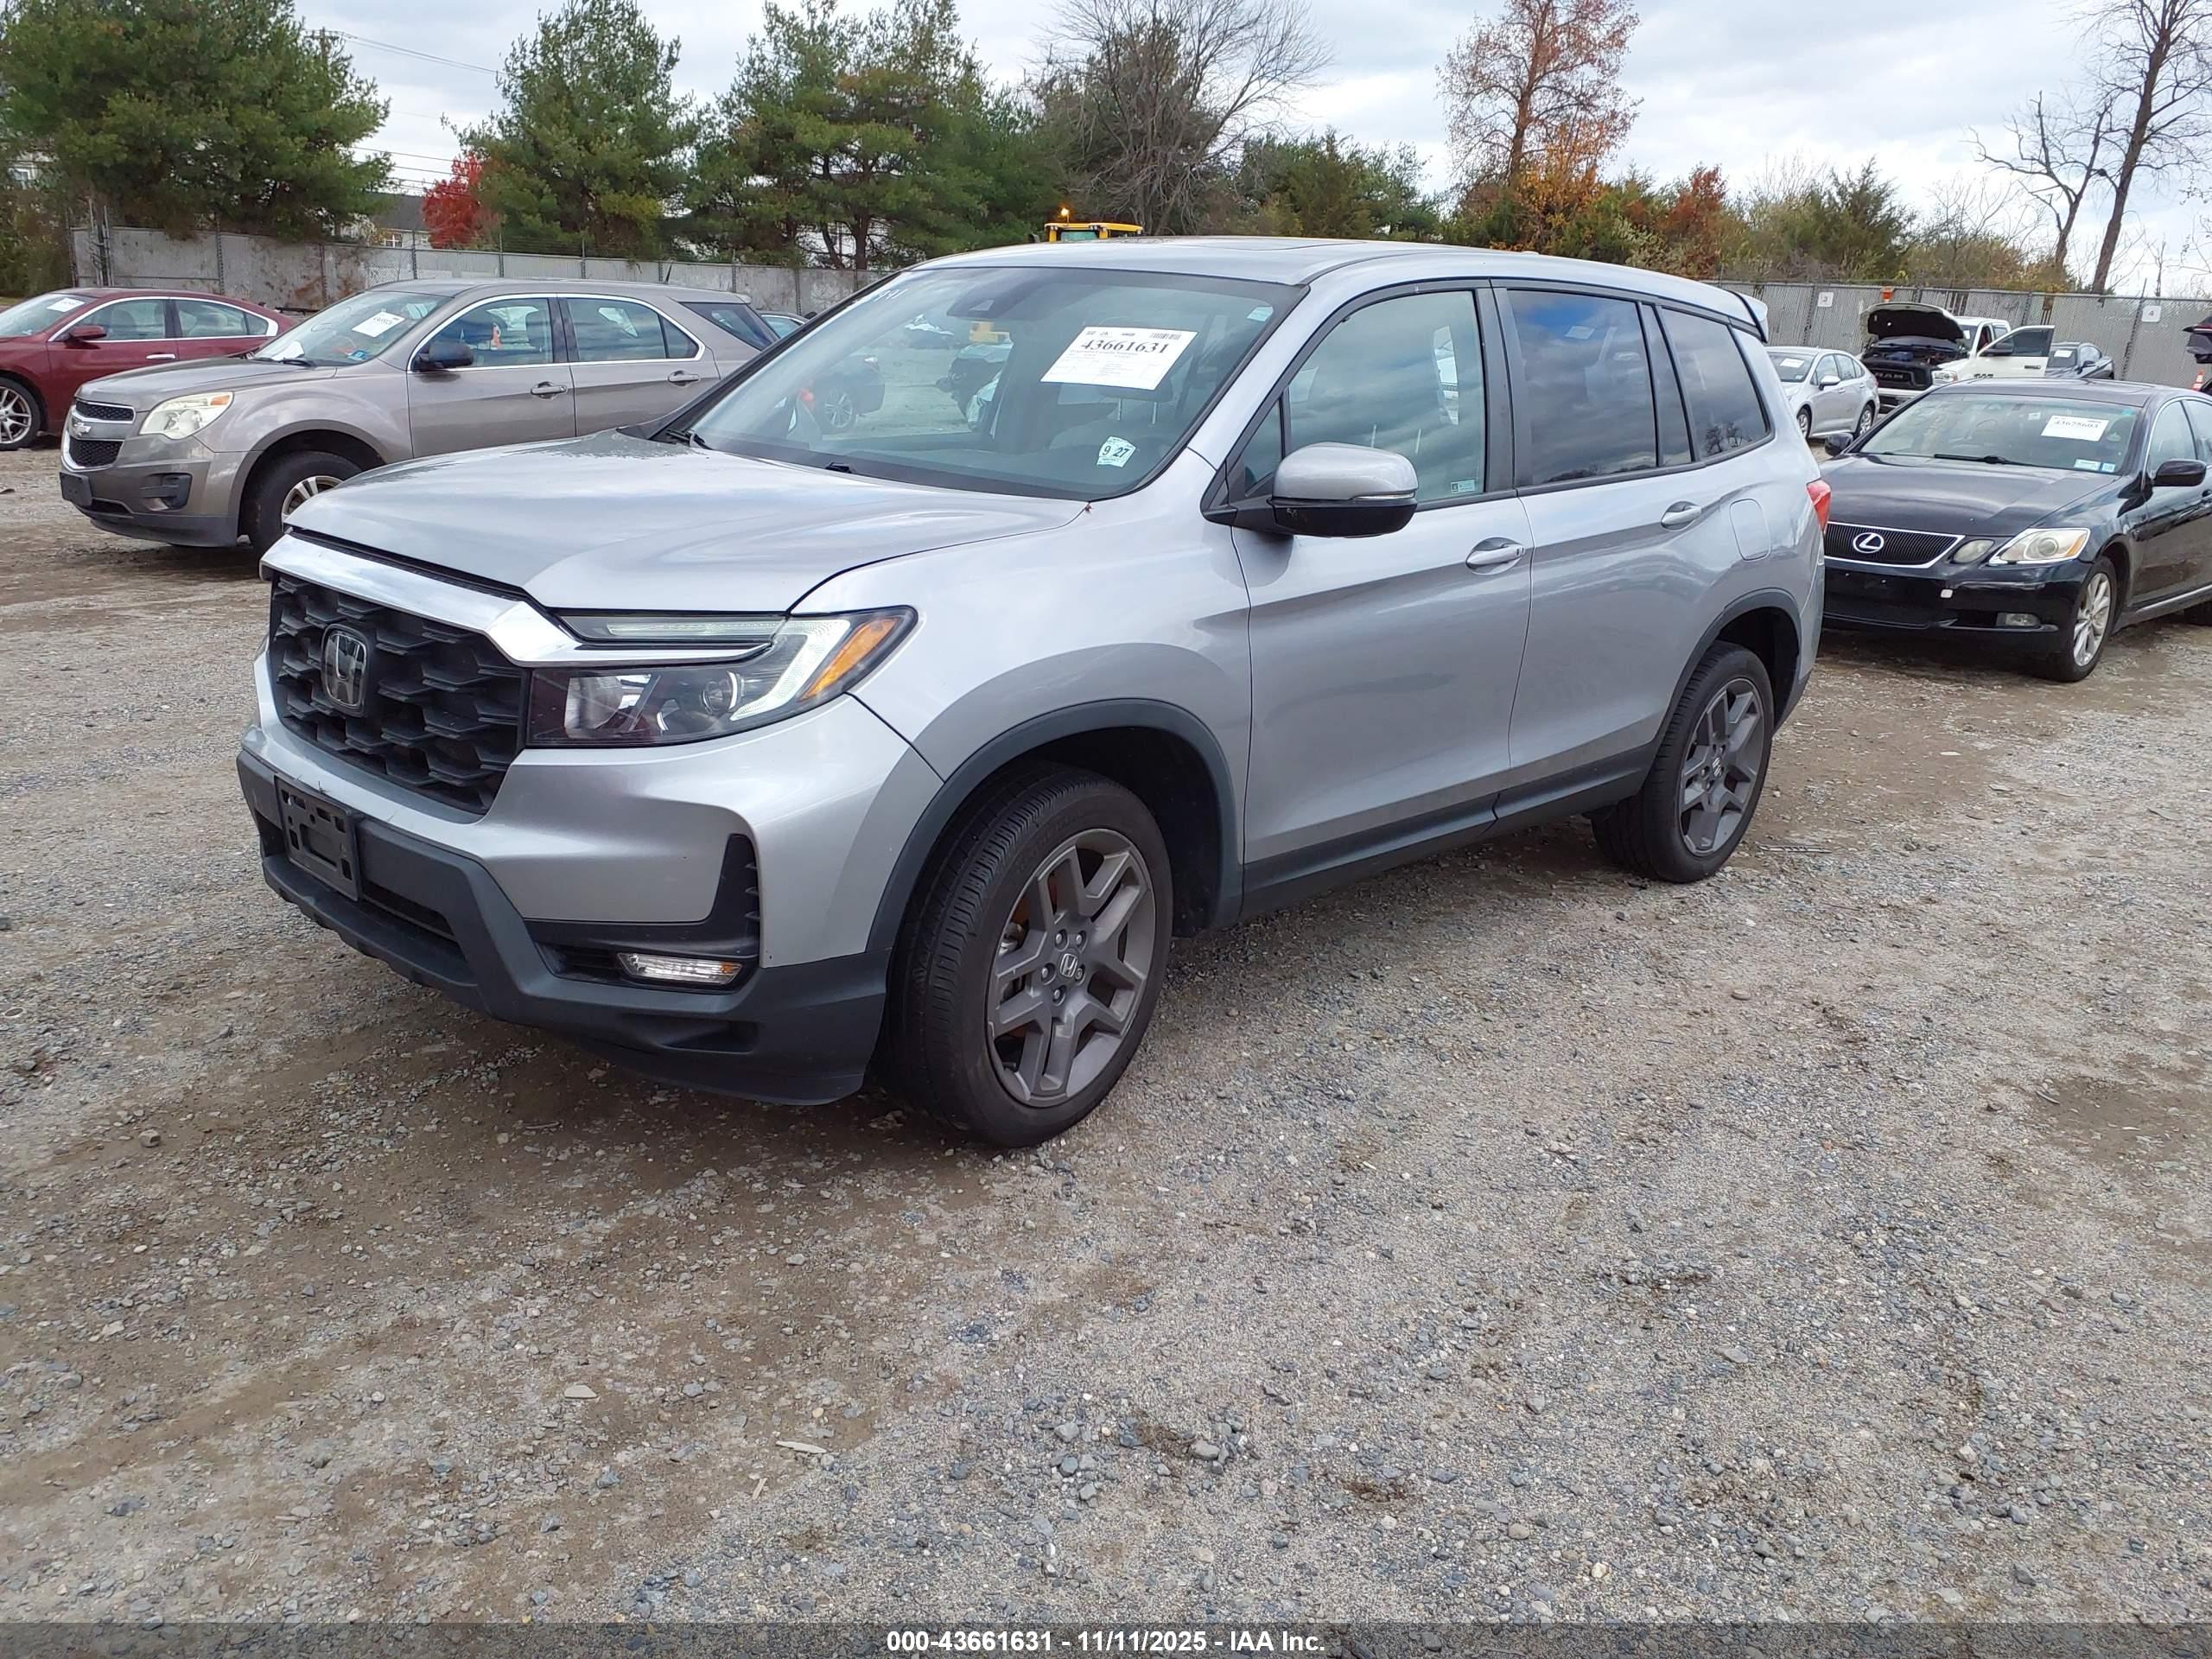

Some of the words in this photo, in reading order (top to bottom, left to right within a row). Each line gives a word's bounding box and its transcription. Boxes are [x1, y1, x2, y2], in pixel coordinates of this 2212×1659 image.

[1081, 340, 1169, 353] 43661631
[1102, 445, 1111, 456] 9
[1112, 447, 1130, 458] 27
